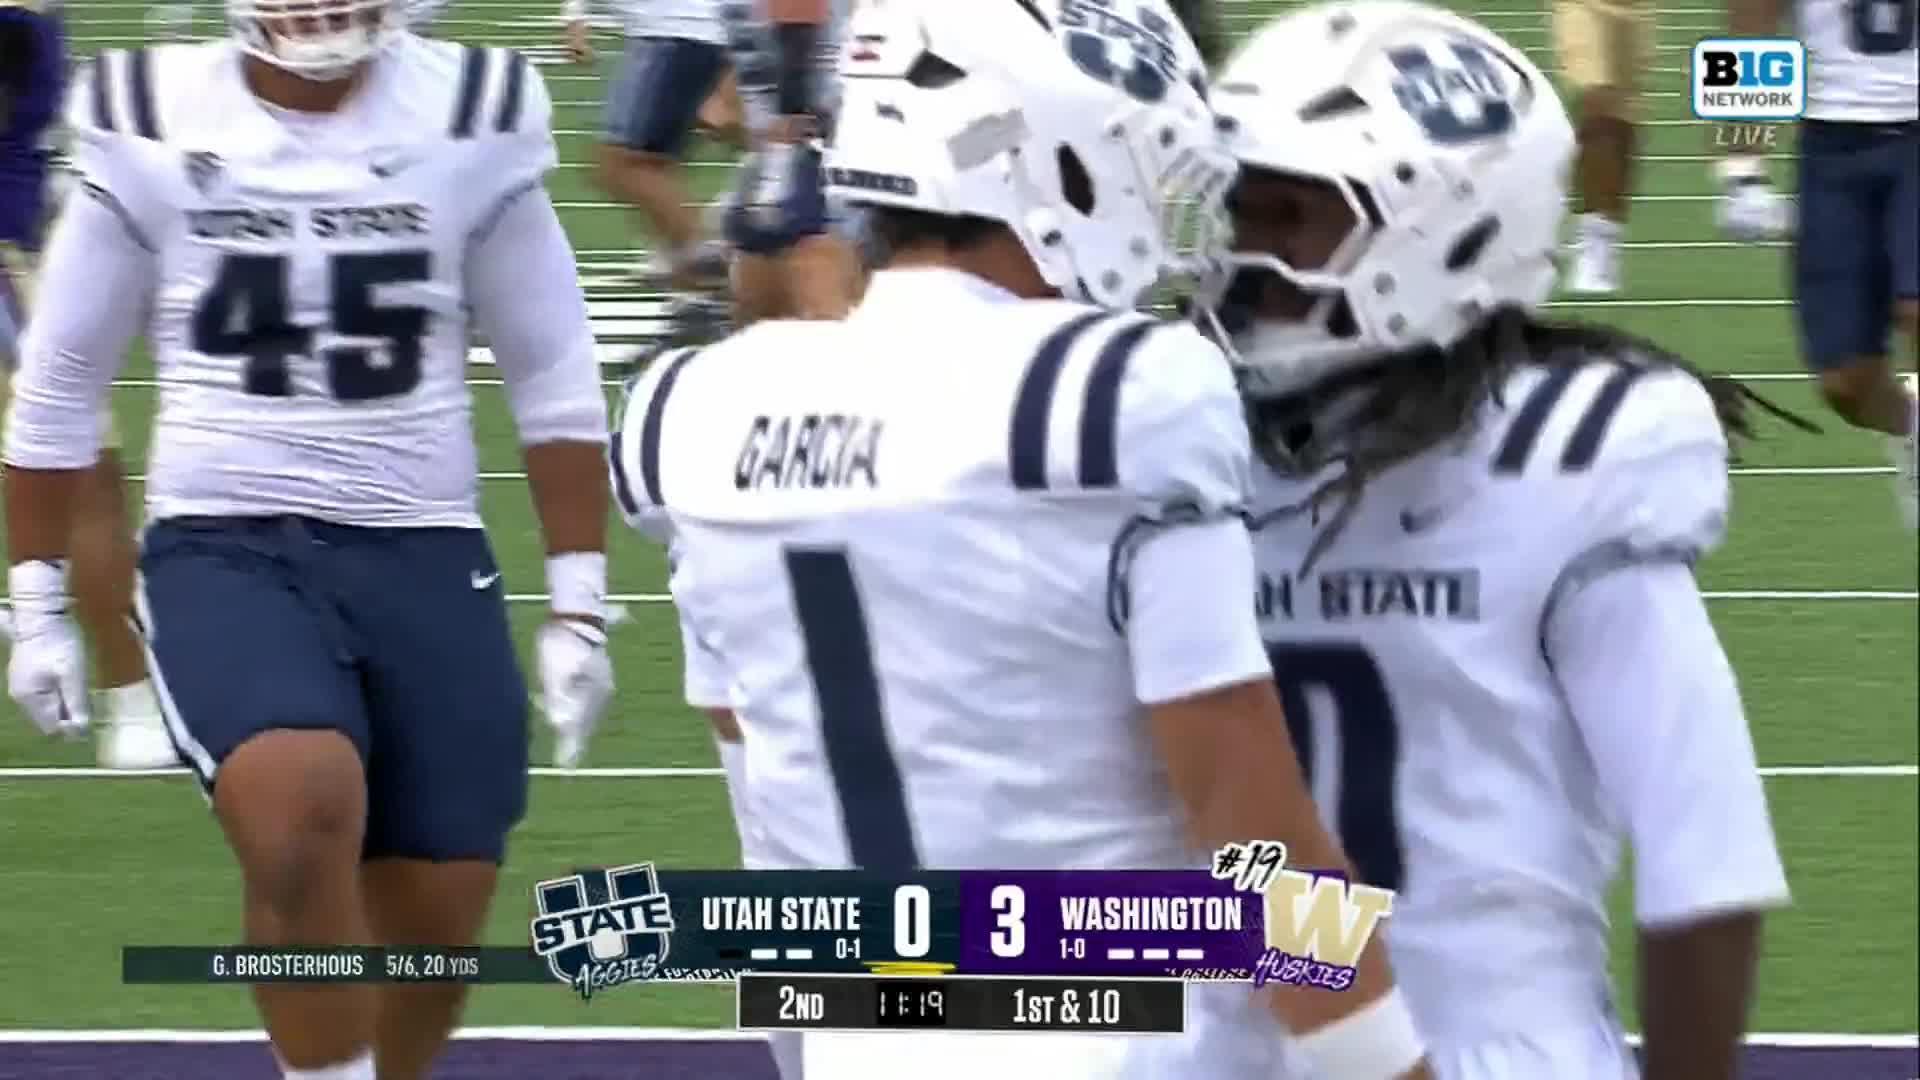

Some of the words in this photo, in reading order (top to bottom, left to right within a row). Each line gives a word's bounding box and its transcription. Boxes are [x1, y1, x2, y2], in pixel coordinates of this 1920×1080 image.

[310, 203, 430, 238] STATE
[190, 250, 432, 402] 45
[735, 414, 884, 490] GARCIA
[1318, 567, 1480, 621] STATE
[781, 543, 922, 869] 1
